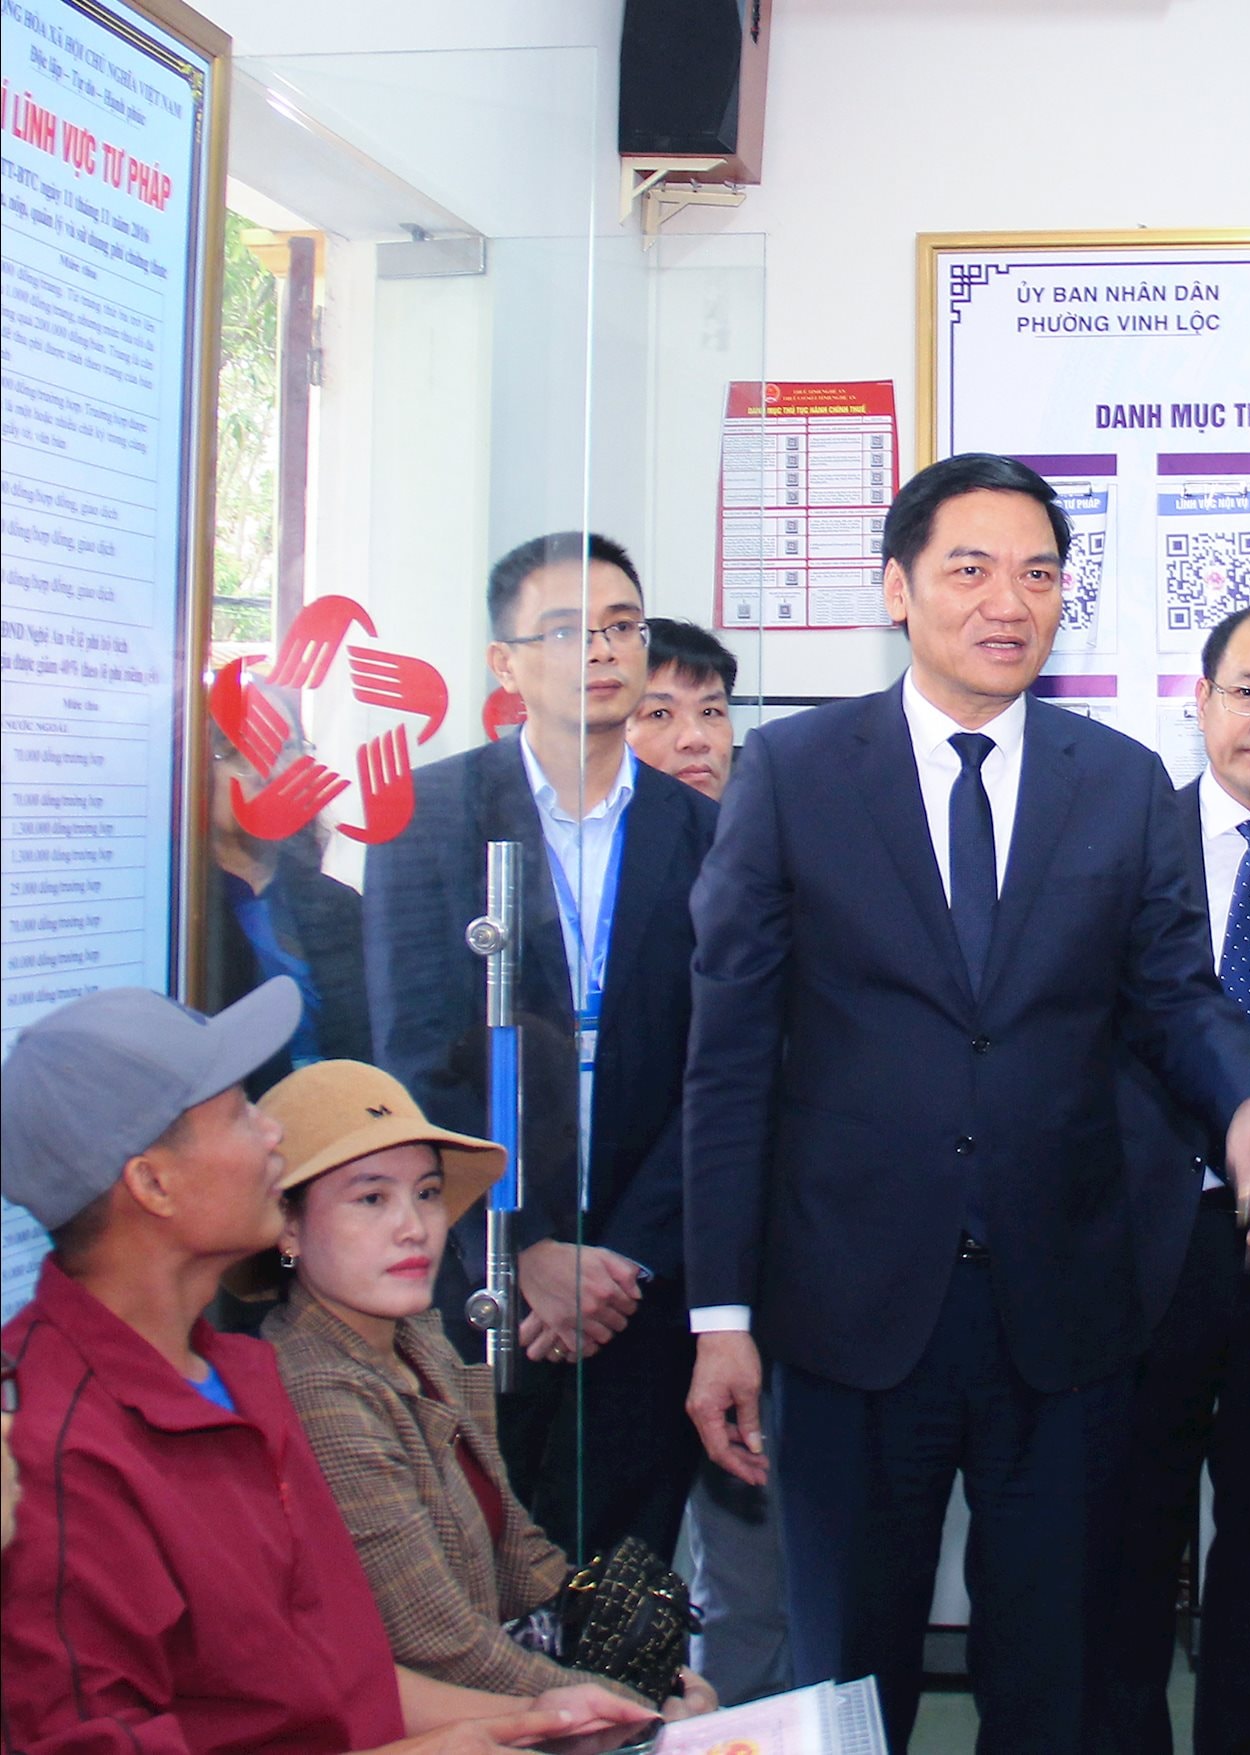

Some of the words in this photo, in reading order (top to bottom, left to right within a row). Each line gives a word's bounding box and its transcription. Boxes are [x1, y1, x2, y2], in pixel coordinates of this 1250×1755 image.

[11, 90, 57, 156] LĨNH
[62, 119, 97, 179] VỰC
[102, 142, 125, 190] TƯ
[127, 158, 173, 212] PHÁP
[1017, 280, 1045, 303] ỦY
[1053, 285, 1098, 303] BAN
[1105, 281, 1166, 302] NHÂN
[1174, 280, 1219, 302] DÂN
[1017, 311, 1109, 333] PHƯỜNG
[1117, 314, 1168, 332] VINH
[1176, 310, 1220, 334] LỘC
[1095, 403, 1162, 429] DANH
[1170, 402, 1226, 432] MỤC
